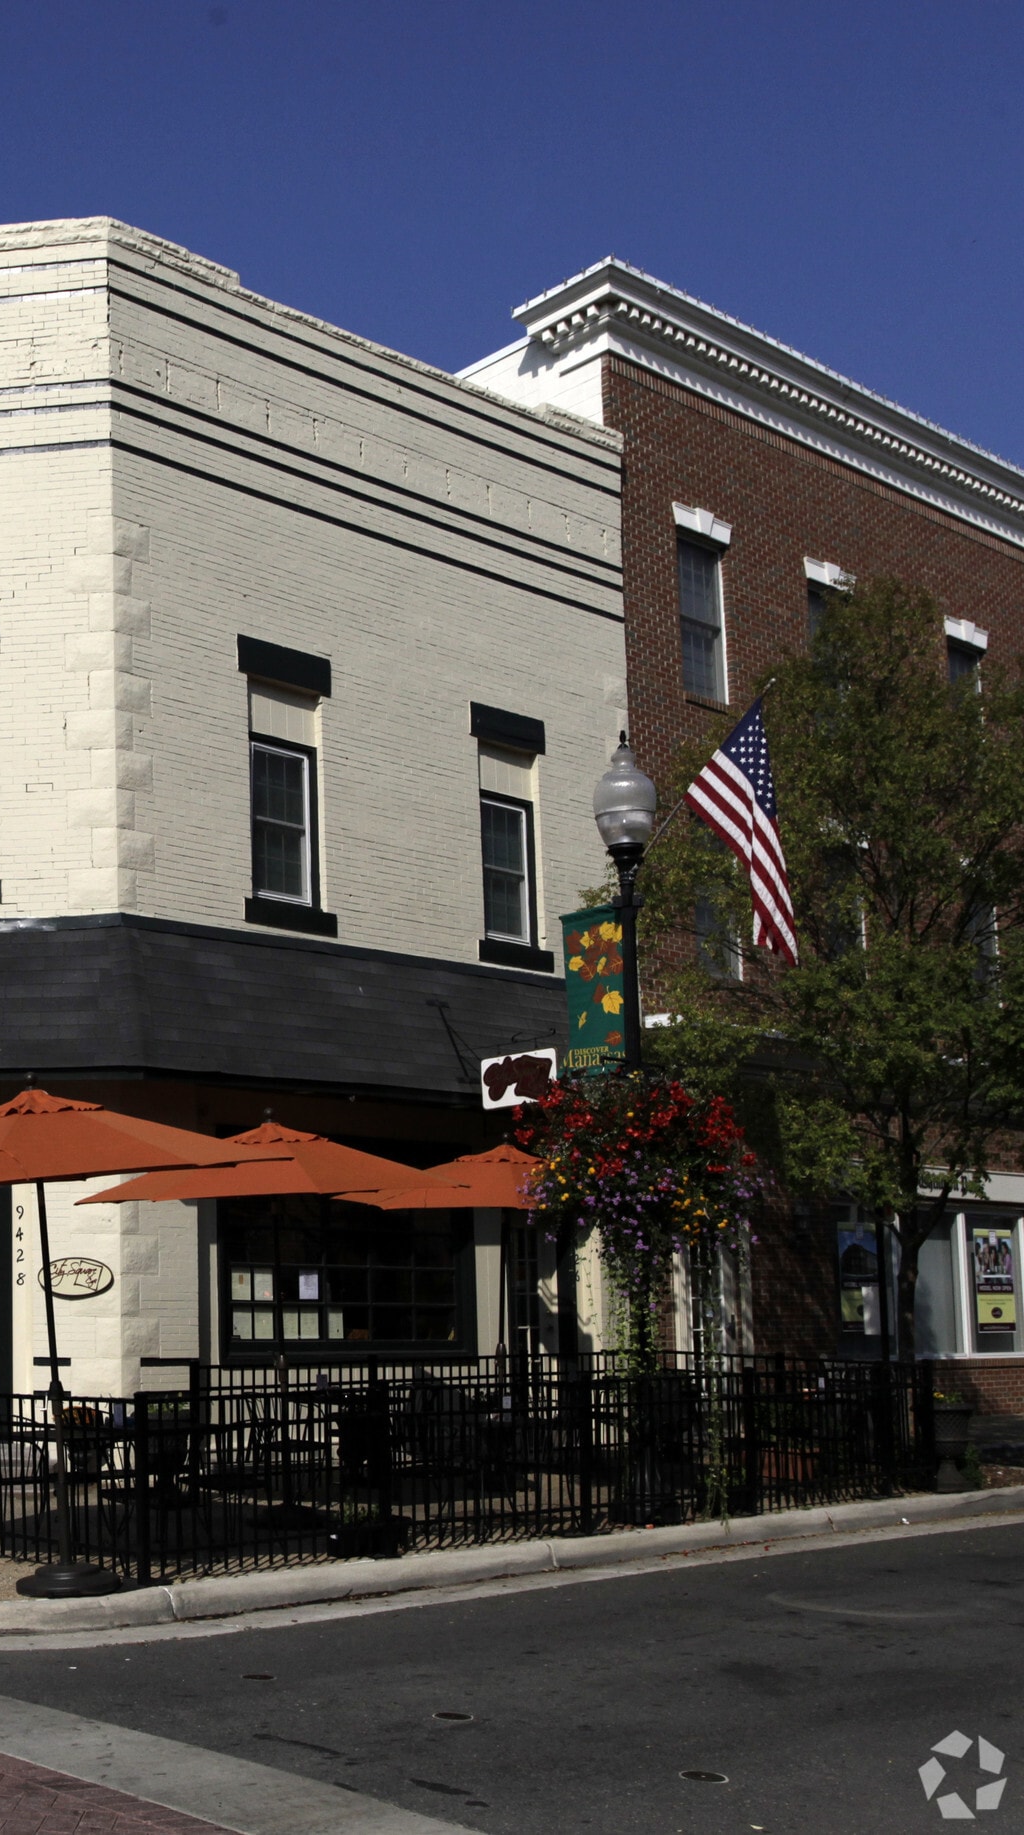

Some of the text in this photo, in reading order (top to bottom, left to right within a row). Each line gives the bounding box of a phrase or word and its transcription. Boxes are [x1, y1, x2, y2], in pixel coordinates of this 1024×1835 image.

[560, 1049, 626, 1069] Manasas
[574, 1046, 609, 1056] DISCOVER
[16, 1205, 27, 1285] 9428
